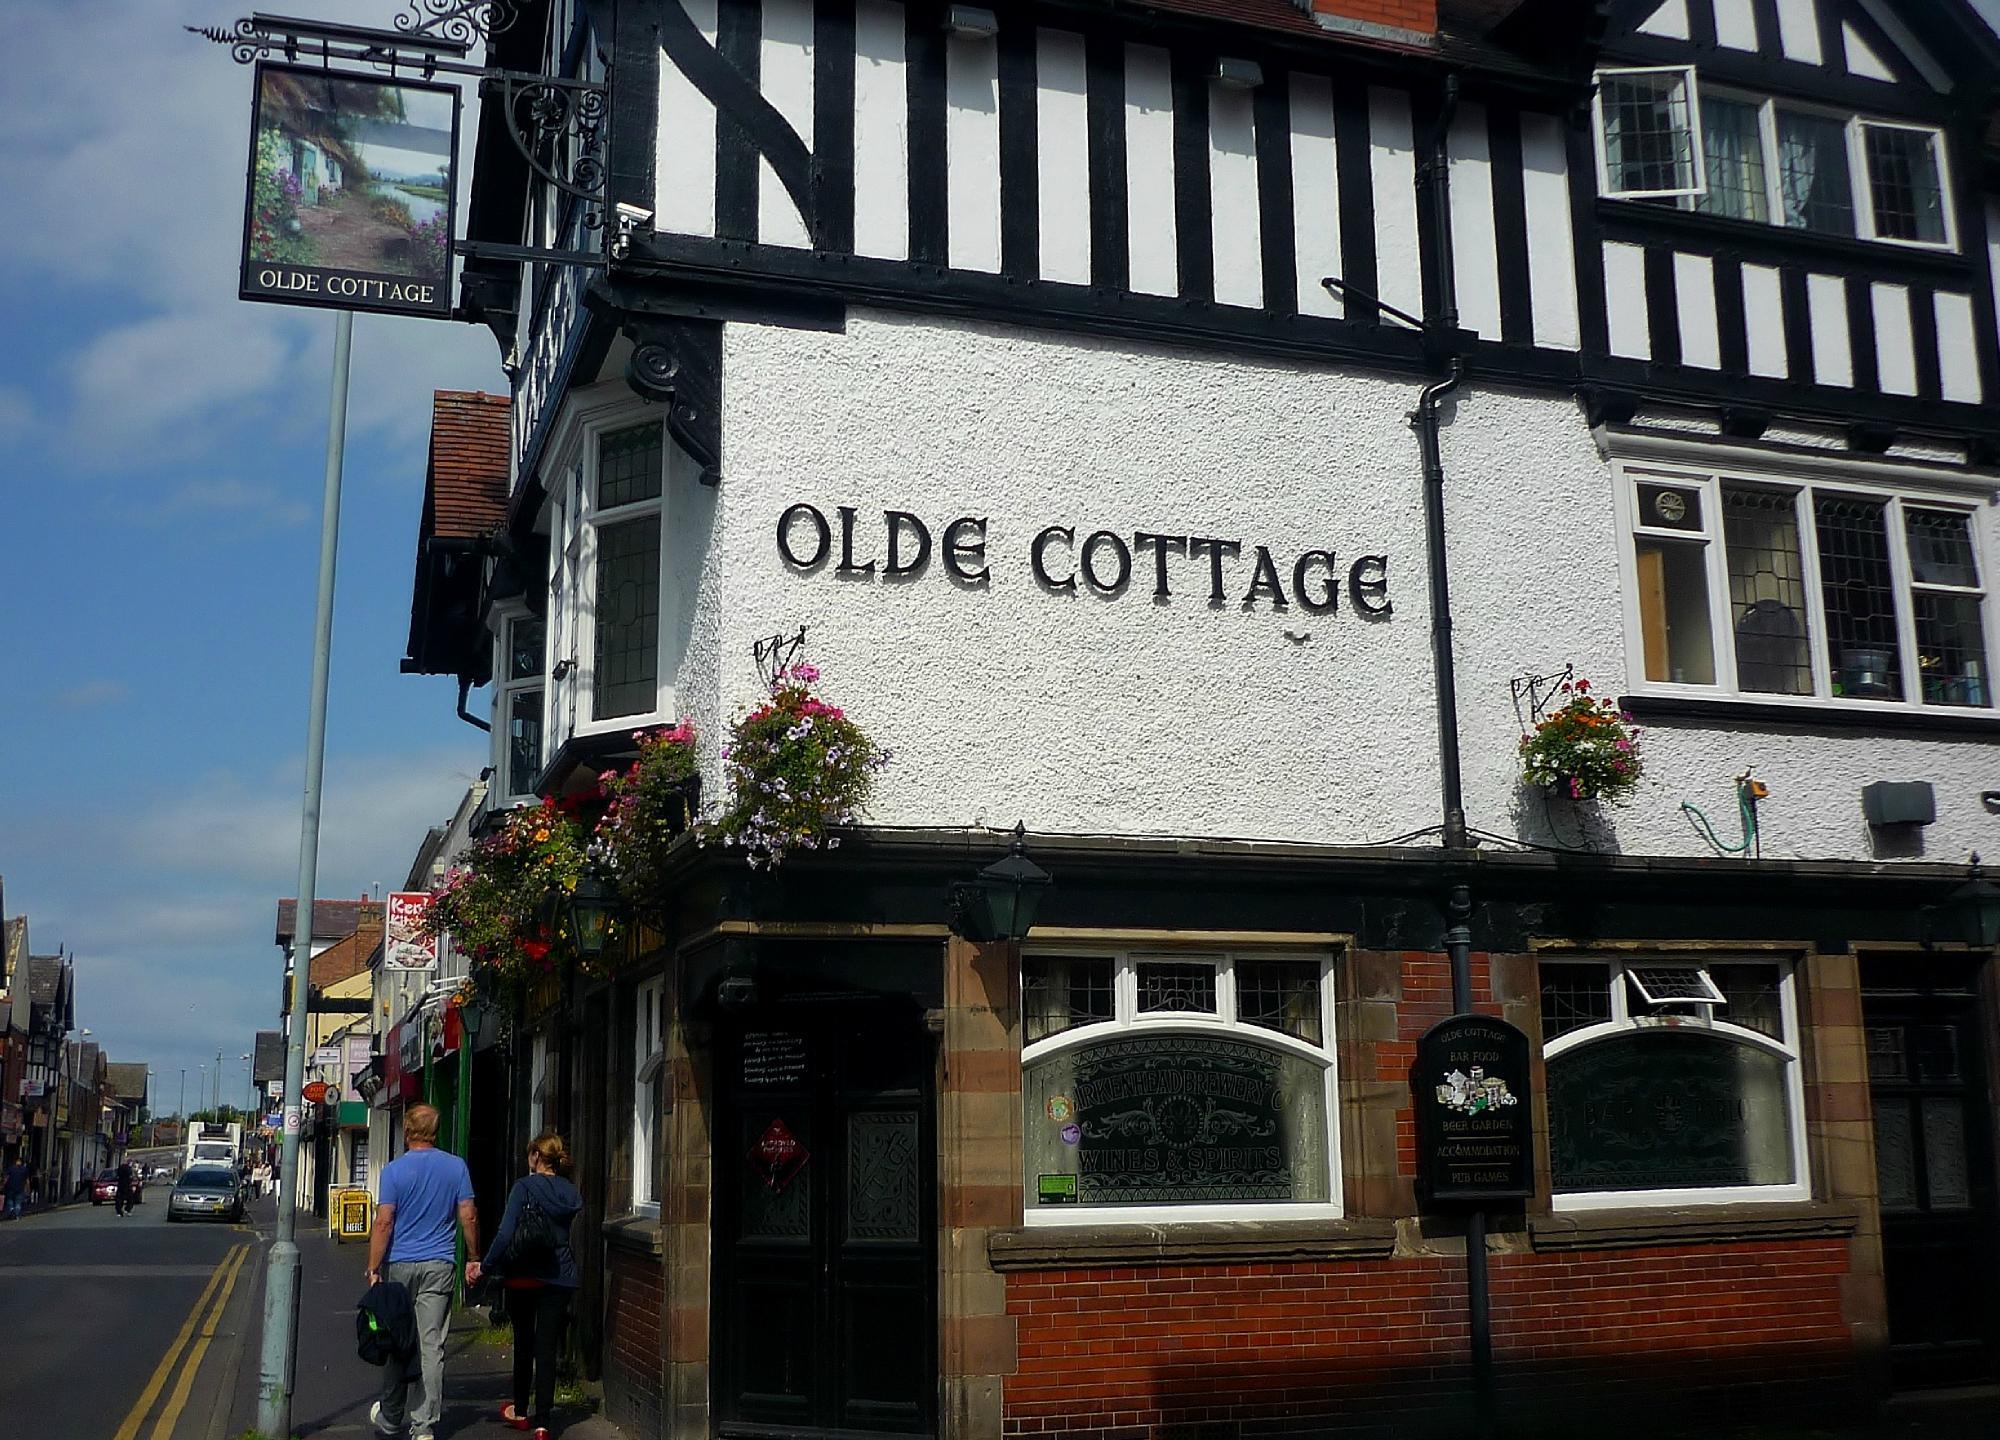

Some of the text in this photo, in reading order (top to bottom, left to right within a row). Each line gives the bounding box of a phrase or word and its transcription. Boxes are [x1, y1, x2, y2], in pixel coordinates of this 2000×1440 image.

[260, 269, 434, 303] OLDE COTTAGE
[776, 502, 1393, 616] OLDE COTTAGE
[1464, 1028, 1506, 1041] COTTAGE
[1450, 1051, 1500, 1062] BAR FOOD
[1073, 1069, 1183, 1112] IRKENHEAD
[1442, 1119, 1513, 1132] BEER GARDEN
[1437, 1144, 1520, 1158] ACCOMMODATION
[1079, 1147, 1281, 1172] WINES & SPIRITS
[1452, 1171, 1510, 1183] PUB GAMES
[346, 1222, 364, 1232] HERE
